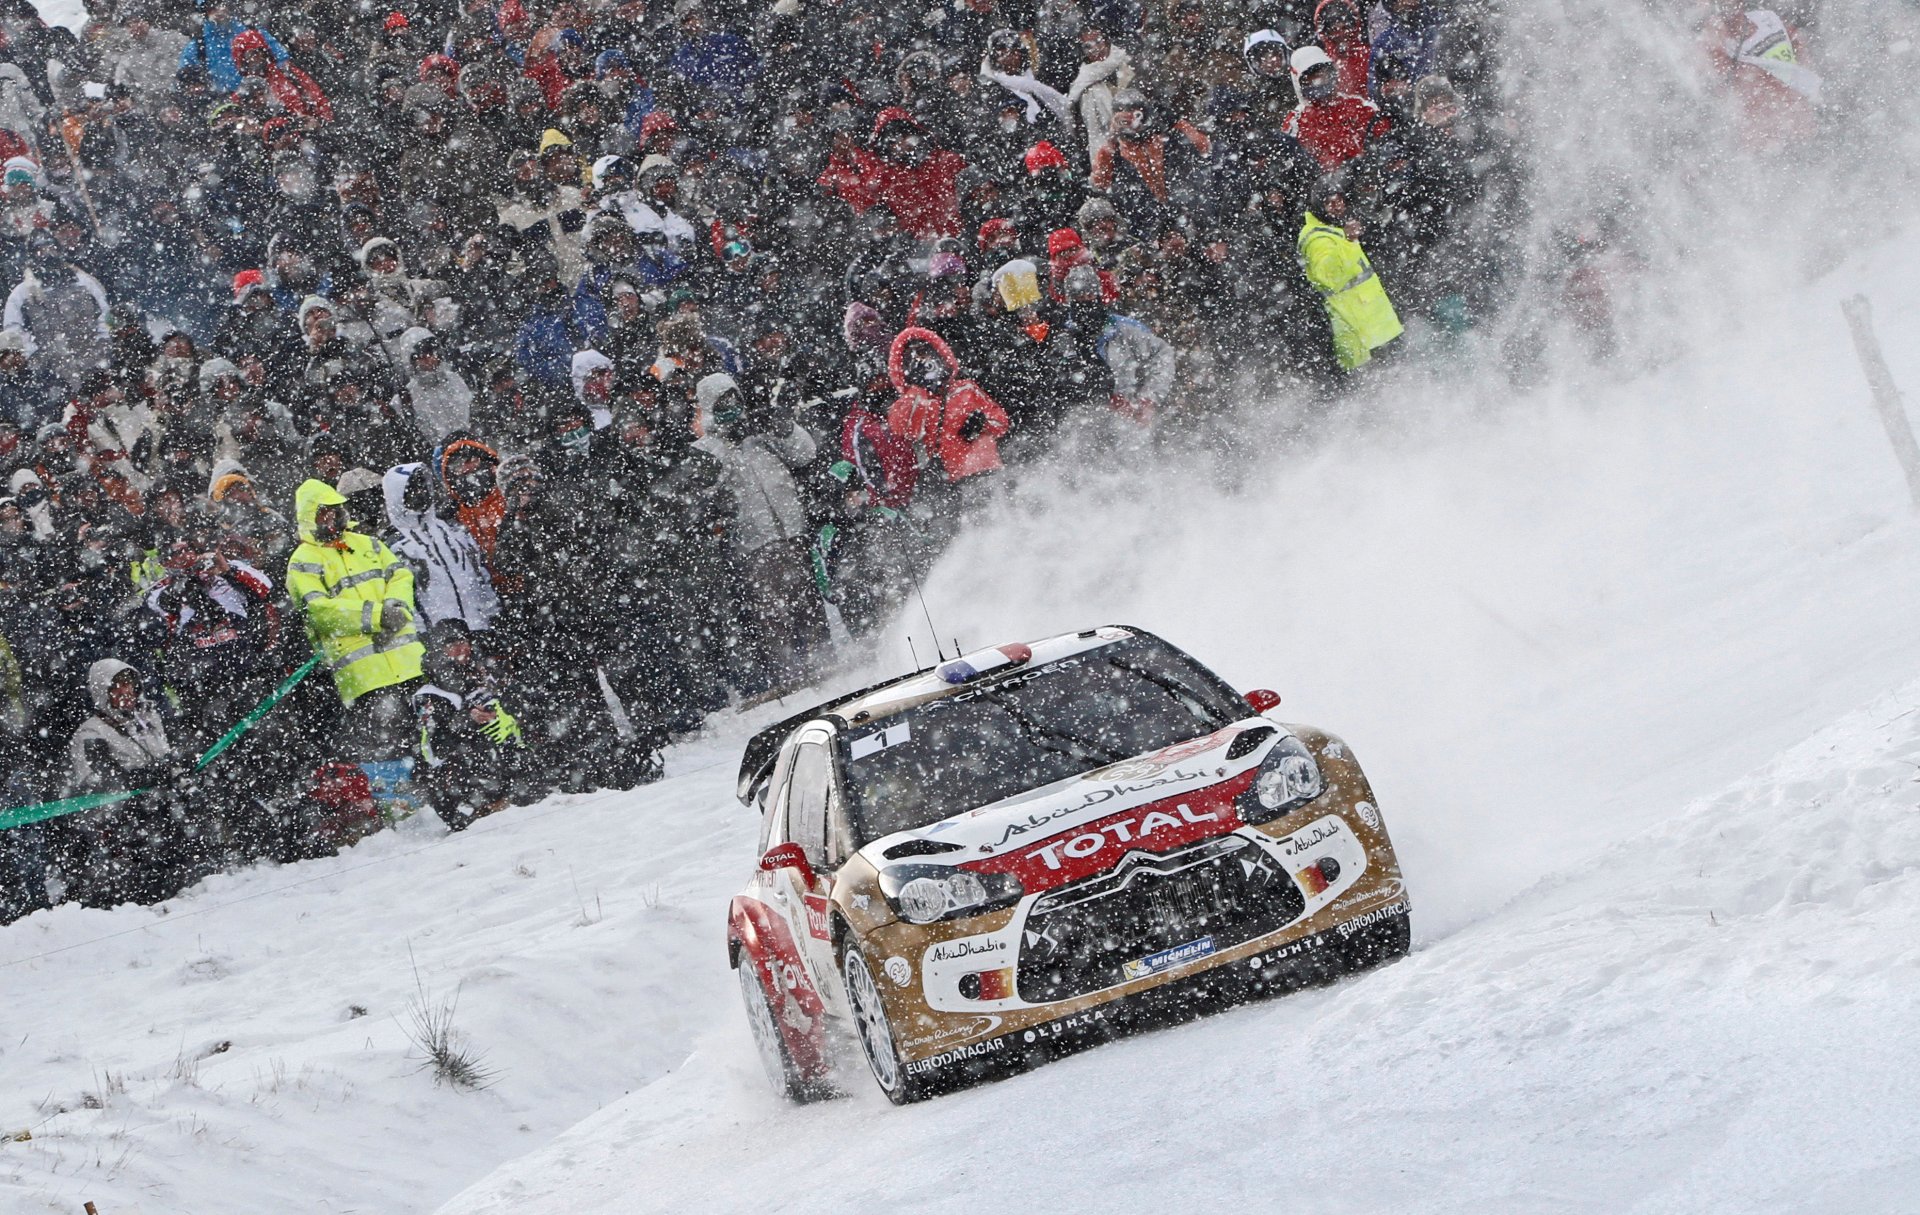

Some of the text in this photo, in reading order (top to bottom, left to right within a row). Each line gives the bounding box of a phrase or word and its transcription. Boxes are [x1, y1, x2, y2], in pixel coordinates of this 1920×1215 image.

[874, 731, 887, 747] 1
[1025, 803, 1220, 870] TOTAL
[764, 852, 798, 865] TOTAL
[1152, 941, 1210, 967] MICHELIN
[1265, 937, 1325, 963] LUHTA
[1038, 1010, 1105, 1038] LUHTA
[906, 1037, 1005, 1075] EURODATACAR
